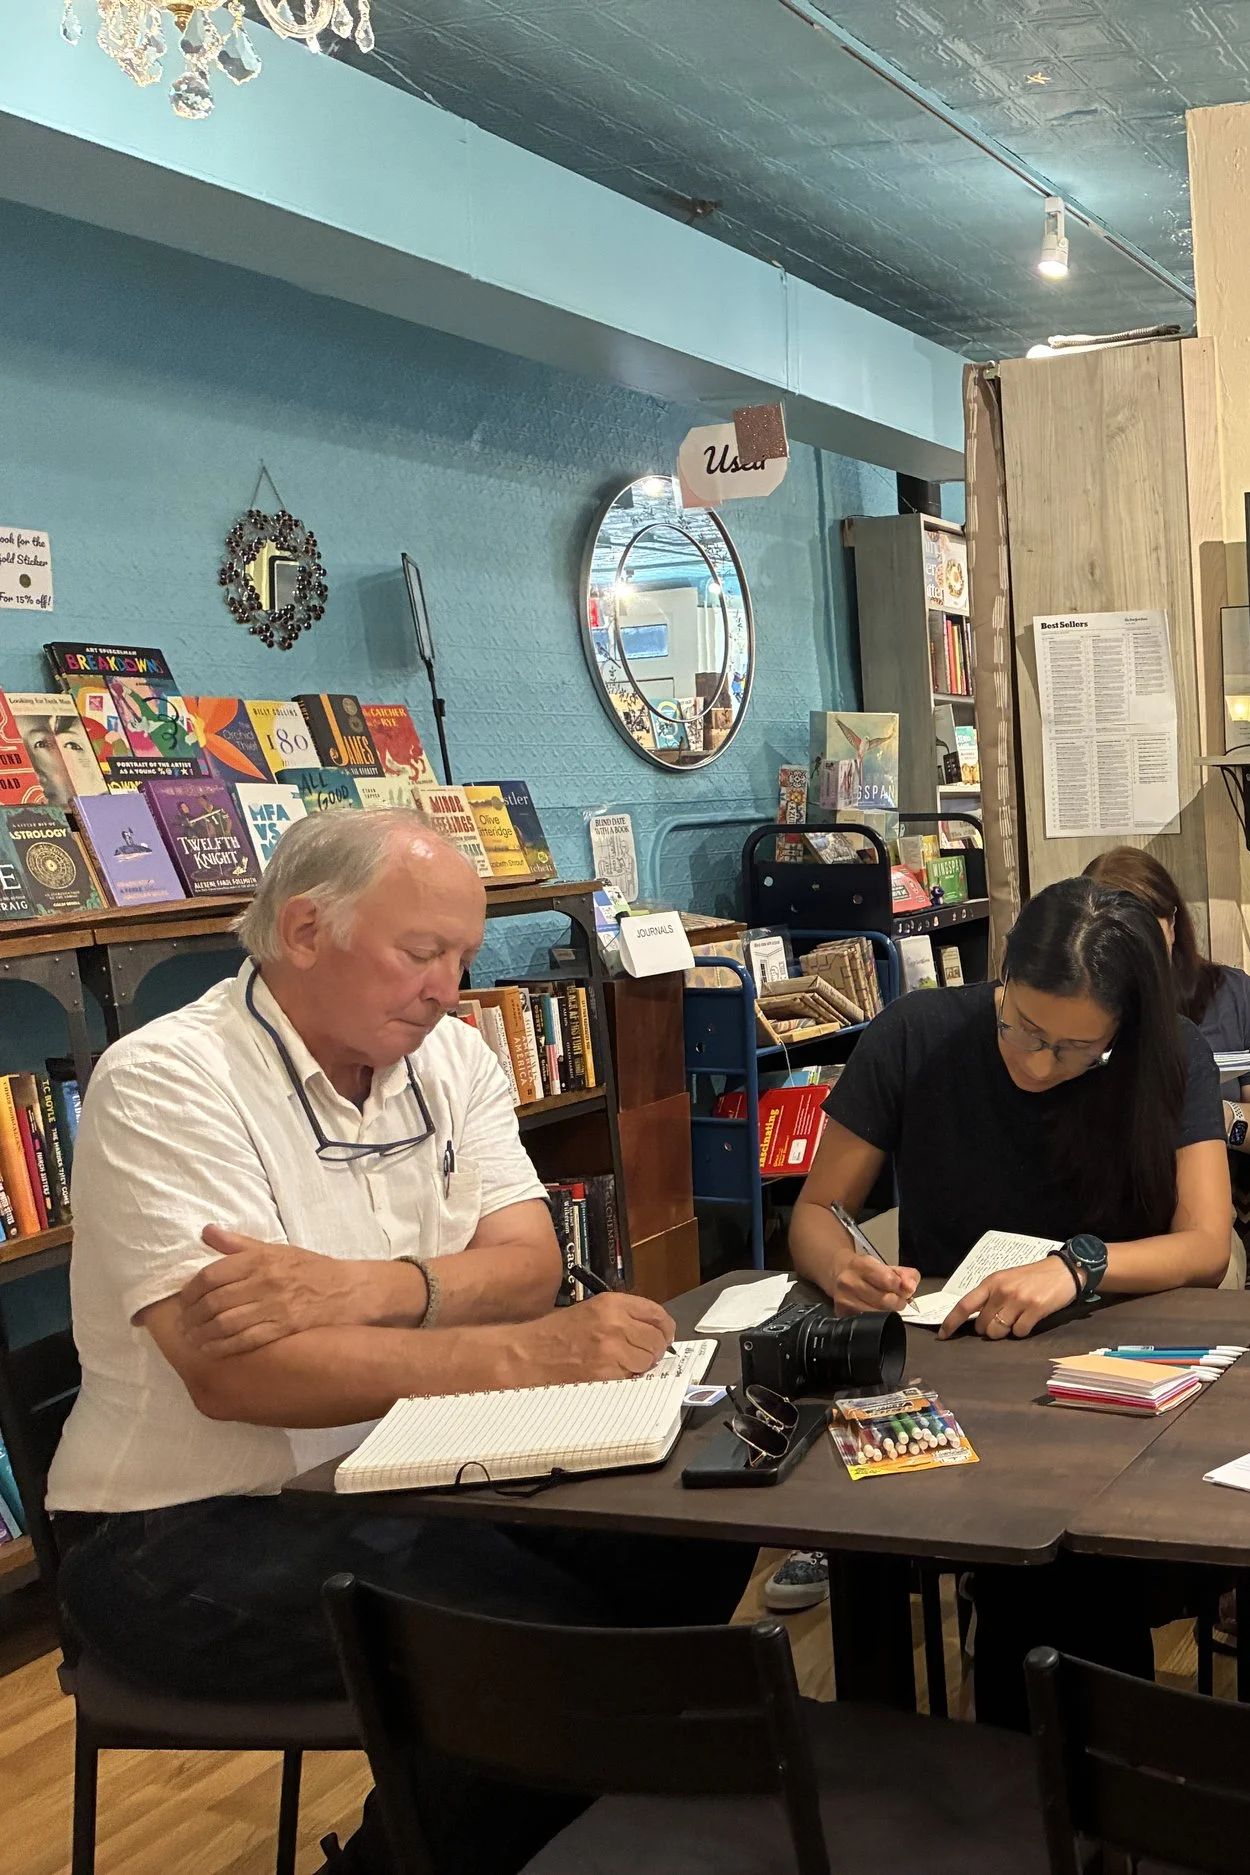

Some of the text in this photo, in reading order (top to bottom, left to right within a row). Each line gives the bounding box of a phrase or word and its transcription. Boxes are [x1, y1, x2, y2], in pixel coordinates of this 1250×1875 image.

[704, 444, 767, 475] Us
[0, 532, 45, 548] ook for the
[17, 554, 48, 567] Sticker
[16, 595, 34, 605] 15%
[36, 594, 51, 608] off!
[1041, 620, 1089, 630] Best Sellers
[65, 653, 164, 674] BREAKDOWNS
[370, 708, 407, 717] CATCHER
[320, 694, 375, 766] JAMES
[381, 718, 398, 727] RYE
[267, 728, 308, 755] 180
[301, 772, 328, 795] ALL
[857, 784, 895, 800] GSPAN
[429, 795, 465, 813] MINOR
[503, 791, 529, 806] stler
[248, 804, 291, 821] MFA
[479, 814, 500, 825] Olive
[595, 817, 626, 827] BLIND DATE
[595, 827, 609, 835] WITH
[614, 825, 629, 834] BOOK
[253, 823, 281, 840] VS
[478, 827, 513, 839] itteridge
[177, 836, 240, 855] TWELFTH
[194, 851, 239, 869] KNIGHT
[932, 858, 964, 877] WINGSPAN
[0, 901, 28, 911] RAIG
[636, 925, 674, 938] JOURNALS
[43, 1095, 56, 1123] BOYLE
[51, 1128, 59, 1141] THE
[40, 1172, 50, 1195] SISTERS
[58, 1168, 67, 1185] THEY
[61, 1186, 70, 1205] COME
[566, 1242, 576, 1284] Case
